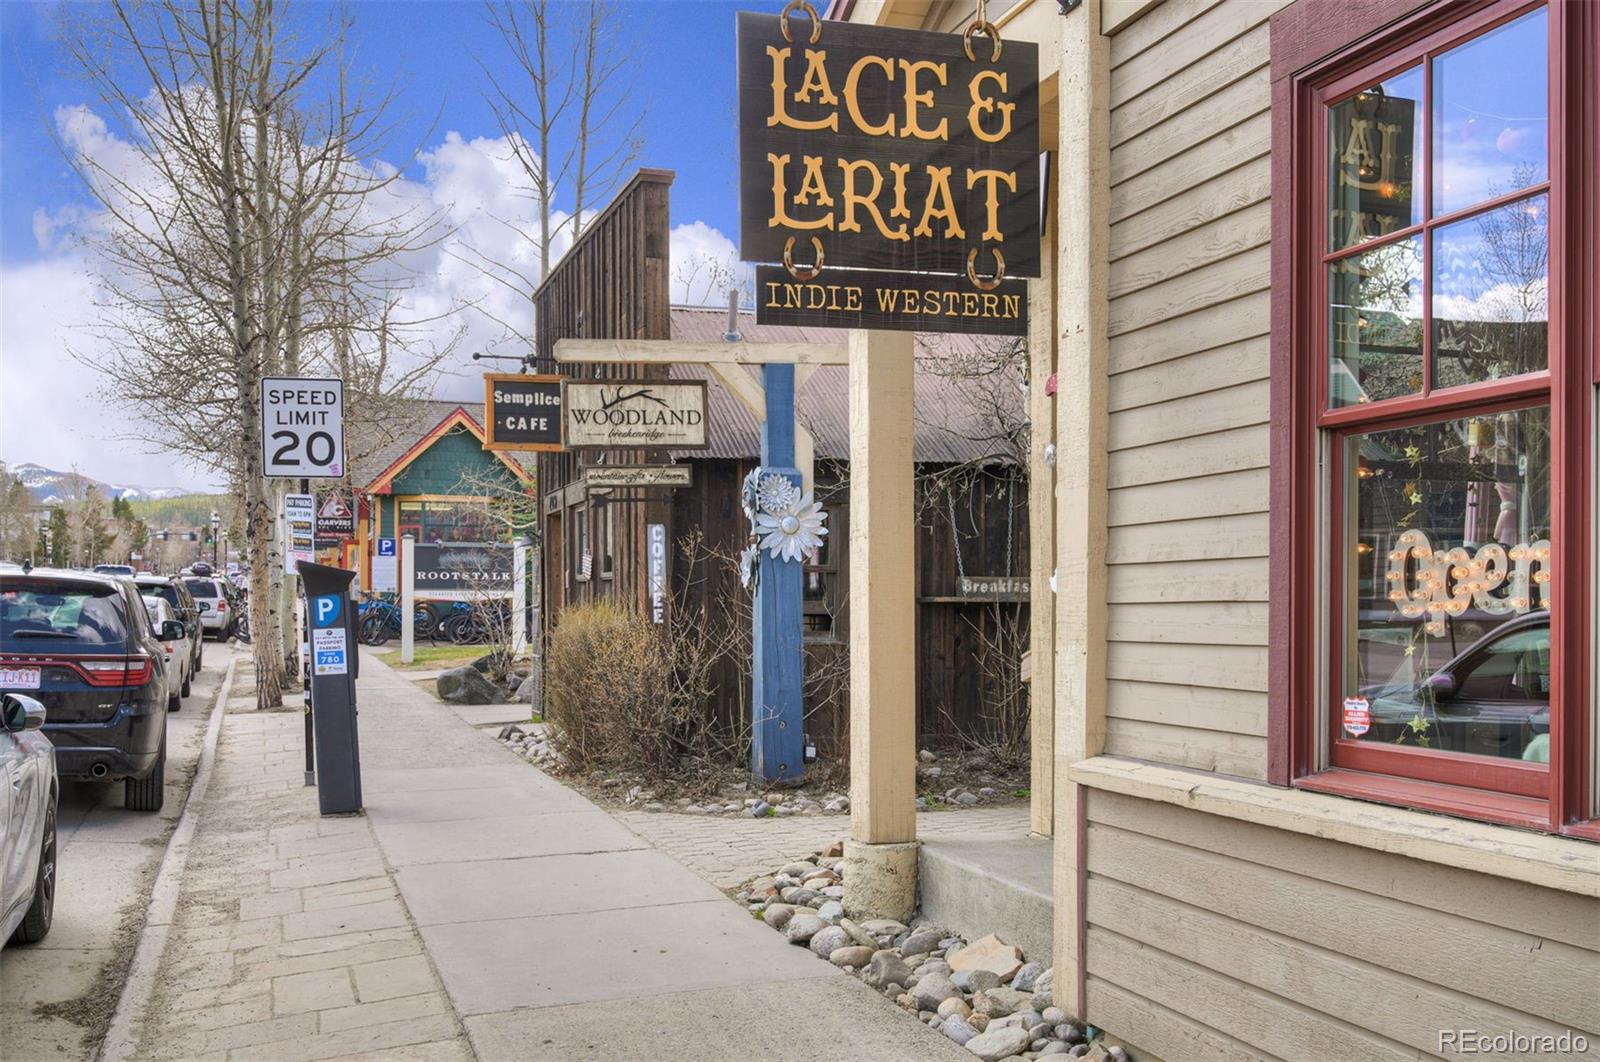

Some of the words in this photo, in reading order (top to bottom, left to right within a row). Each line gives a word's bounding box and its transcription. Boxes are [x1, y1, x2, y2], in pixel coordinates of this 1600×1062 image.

[767, 45, 948, 141] LACE
[967, 70, 1016, 143] &
[768, 152, 1017, 242] LARIAT
[766, 282, 862, 311] INDIE
[876, 288, 1021, 318] WESTERN
[269, 389, 337, 405] SPEED
[494, 390, 560, 407] Semplice
[277, 410, 329, 425] LIMIT
[505, 416, 548, 431] CAFE
[571, 408, 702, 425] WOODLAND
[271, 430, 336, 467] 20
[381, 540, 392, 551] P
[416, 571, 511, 580] ROOTSTALK
[652, 526, 664, 624] COFFEE
[1386, 529, 1550, 637] Open
[961, 579, 1030, 593] Breakfas
[318, 598, 334, 621] P
